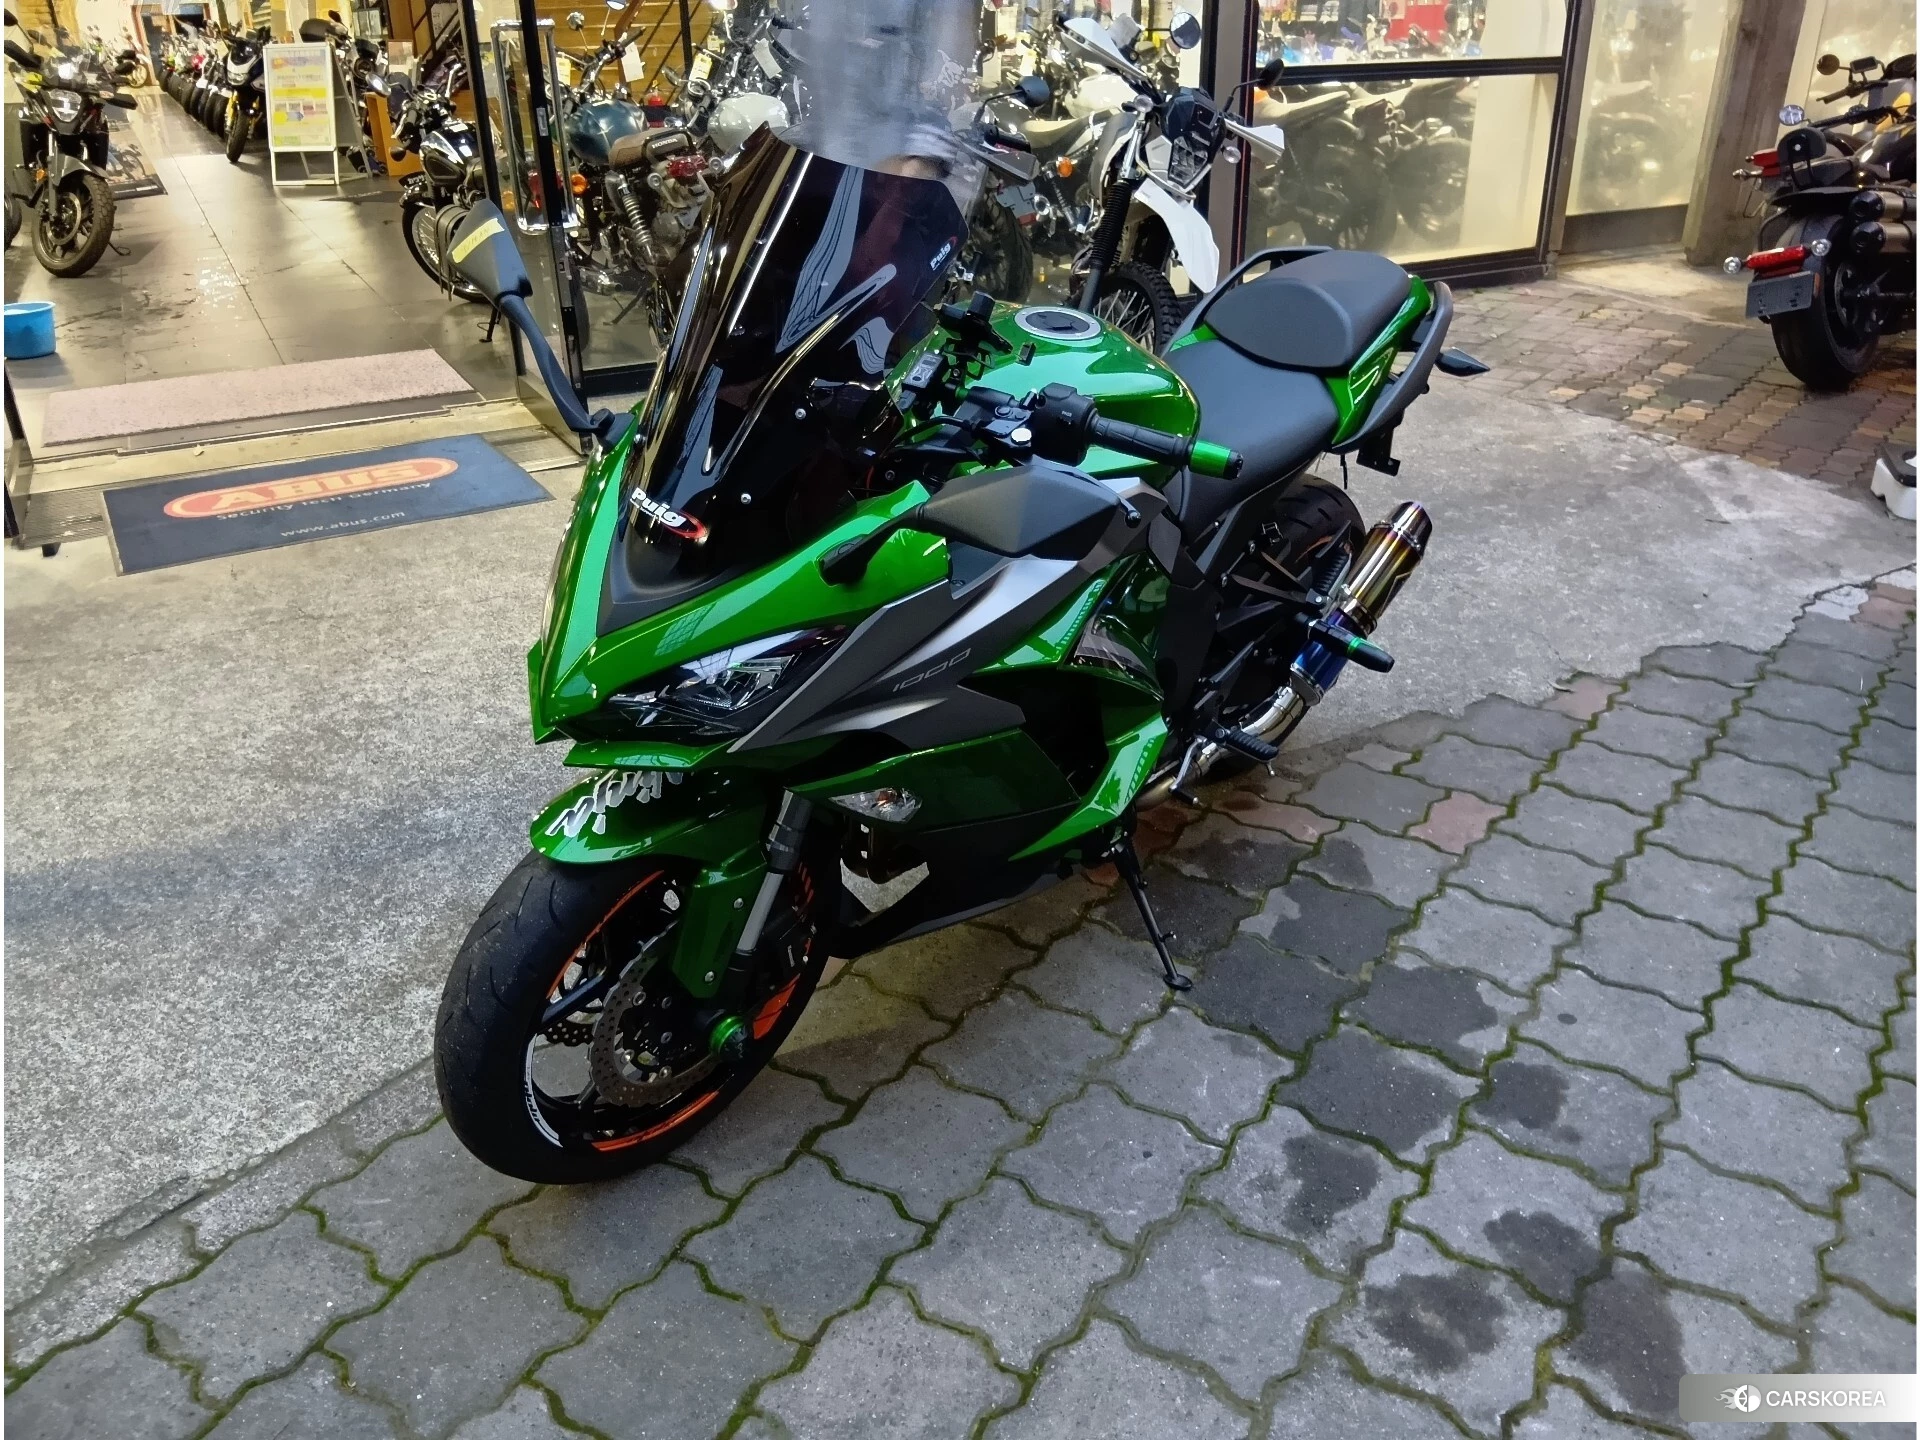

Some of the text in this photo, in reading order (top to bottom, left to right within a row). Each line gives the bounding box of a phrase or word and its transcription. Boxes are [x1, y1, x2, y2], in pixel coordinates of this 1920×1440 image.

[652, 138, 678, 149] HONDA
[930, 243, 951, 269] Puig
[210, 464, 421, 511] ABUS
[631, 486, 688, 528] Puig
[280, 511, 406, 538] www.abus.com
[892, 647, 972, 693] 1000
